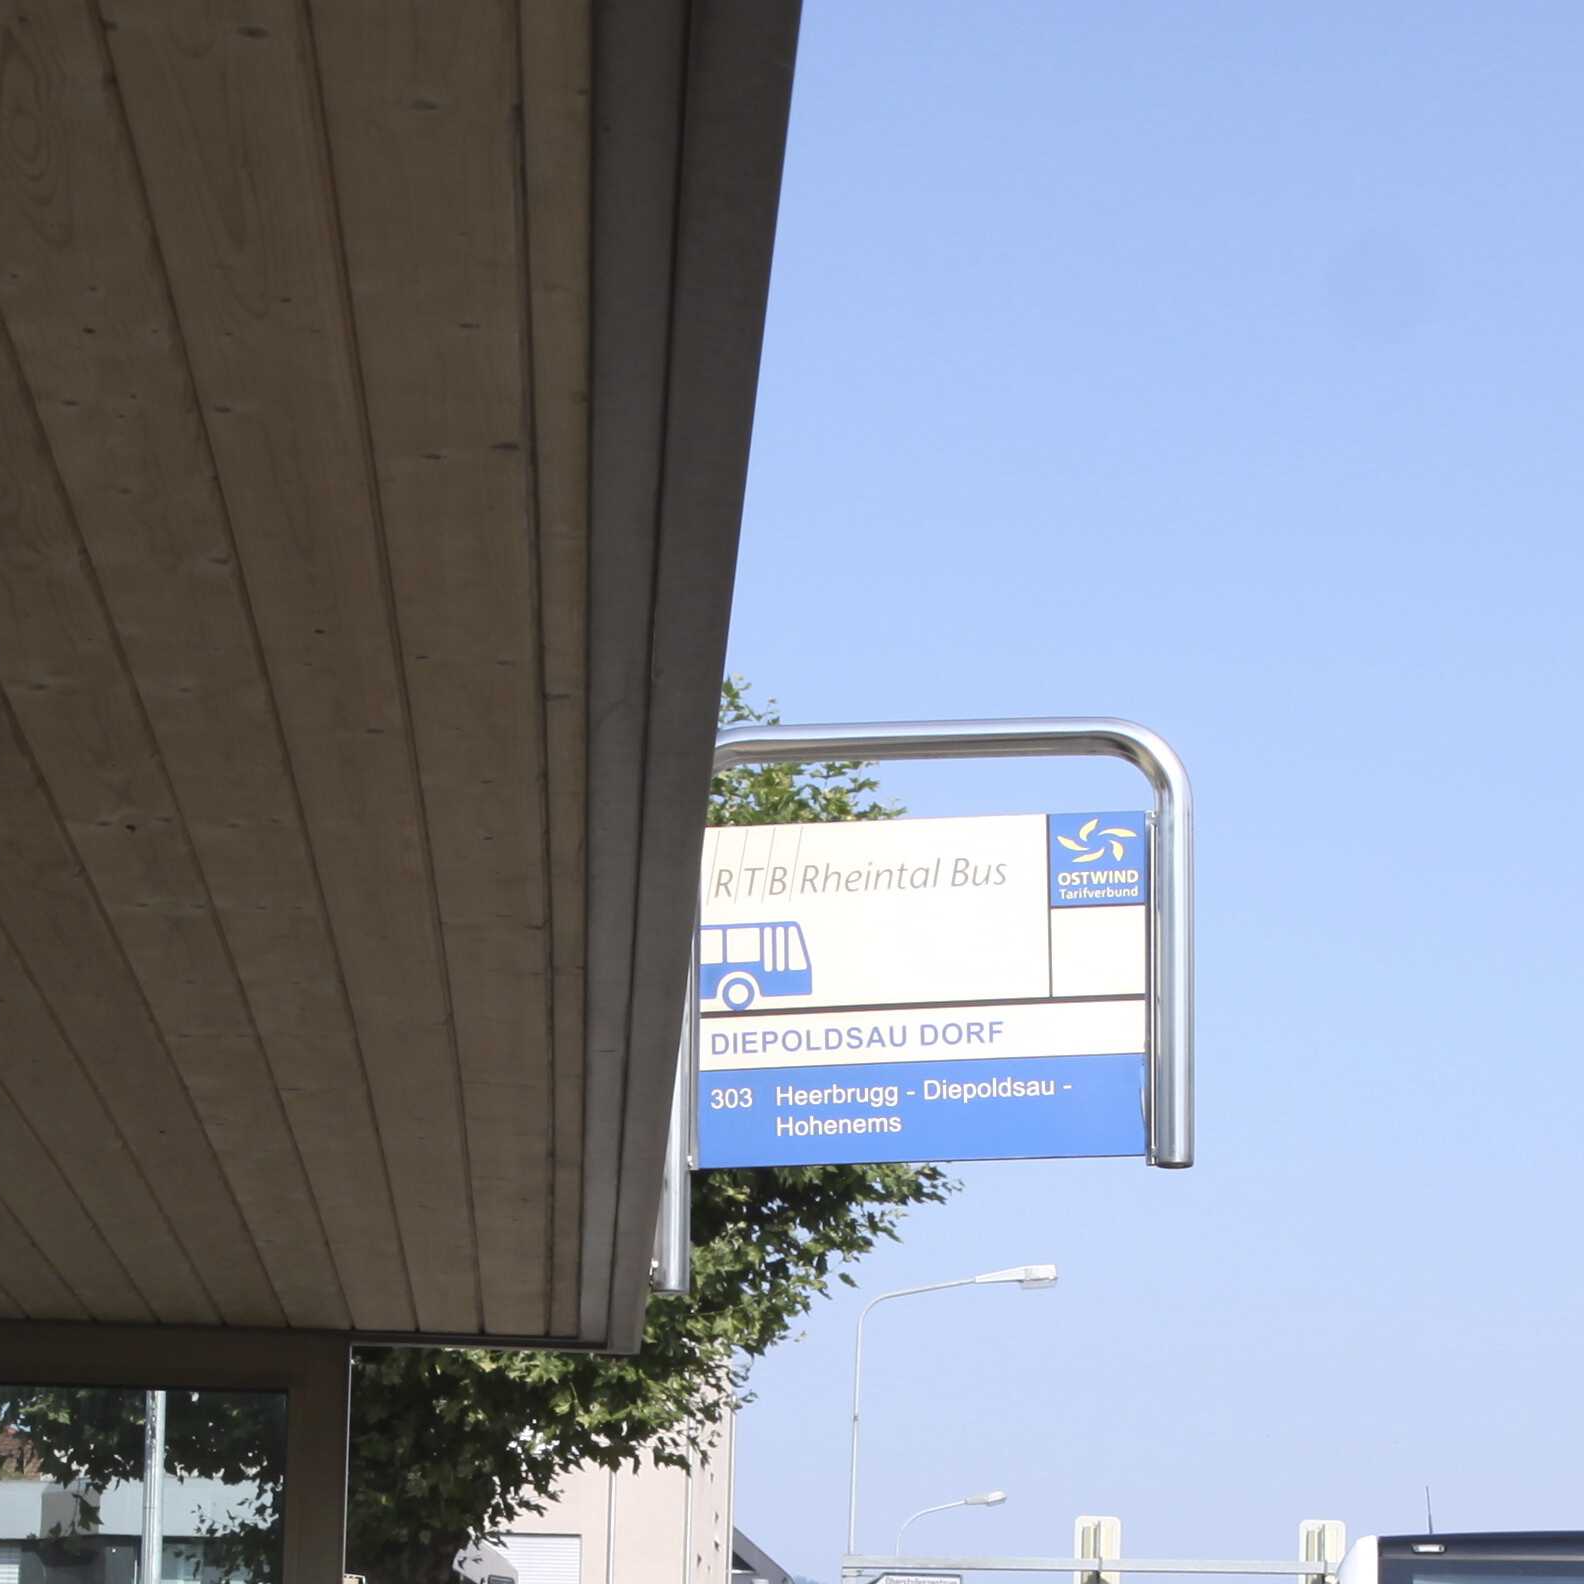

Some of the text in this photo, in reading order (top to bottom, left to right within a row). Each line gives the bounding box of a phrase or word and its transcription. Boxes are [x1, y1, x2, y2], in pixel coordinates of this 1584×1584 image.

[800, 858, 941, 894] Rheintal
[951, 857, 1007, 888] Bus
[1058, 868, 1139, 886] OSTWIND
[1059, 885, 1139, 900] Tarifverbund
[711, 1021, 1004, 1055] DIEPOLDSAU DORF
[711, 1088, 753, 1110] 303
[776, 1081, 899, 1111] Heerbrugg
[923, 1078, 1055, 1102] Diepoldsau
[777, 1115, 902, 1137] Hohenems
